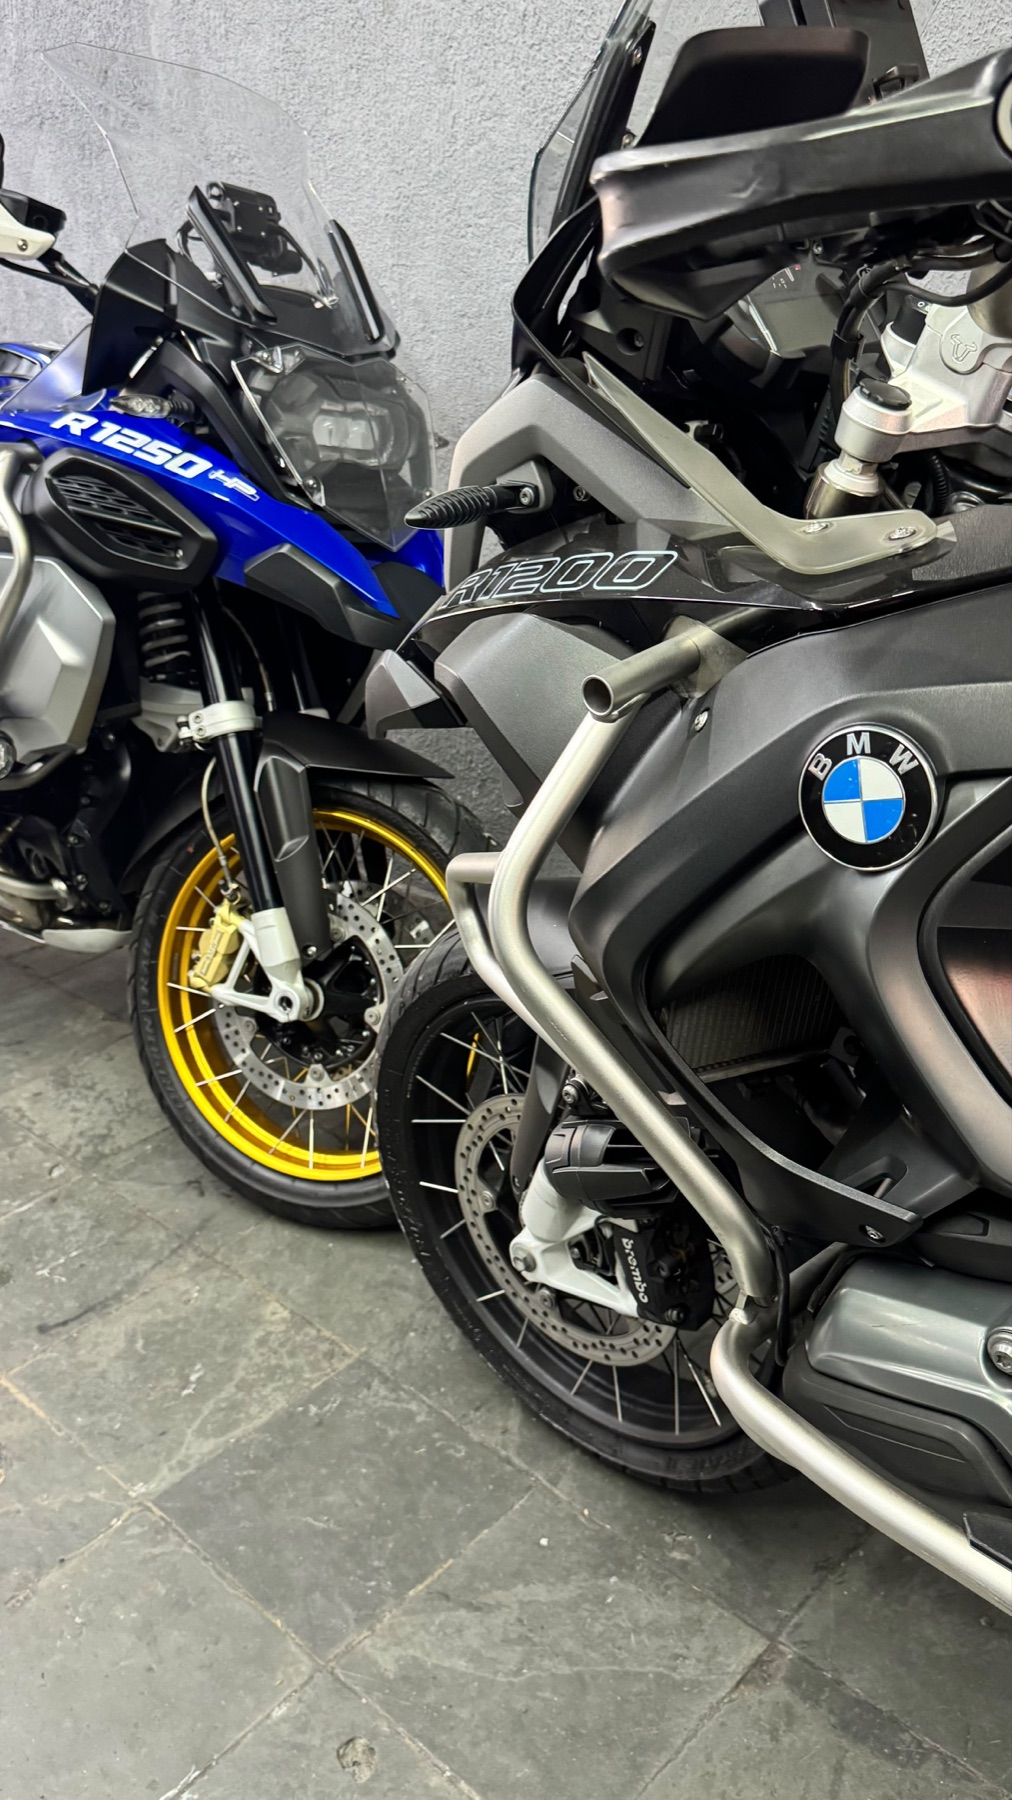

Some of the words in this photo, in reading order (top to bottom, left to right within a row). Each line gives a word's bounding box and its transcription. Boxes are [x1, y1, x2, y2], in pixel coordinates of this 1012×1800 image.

[50, 412, 98, 436] R
[90, 421, 213, 479] 1250
[436, 550, 678, 611] R1200
[808, 731, 919, 781] BMW
[621, 1237, 649, 1303] brembo
